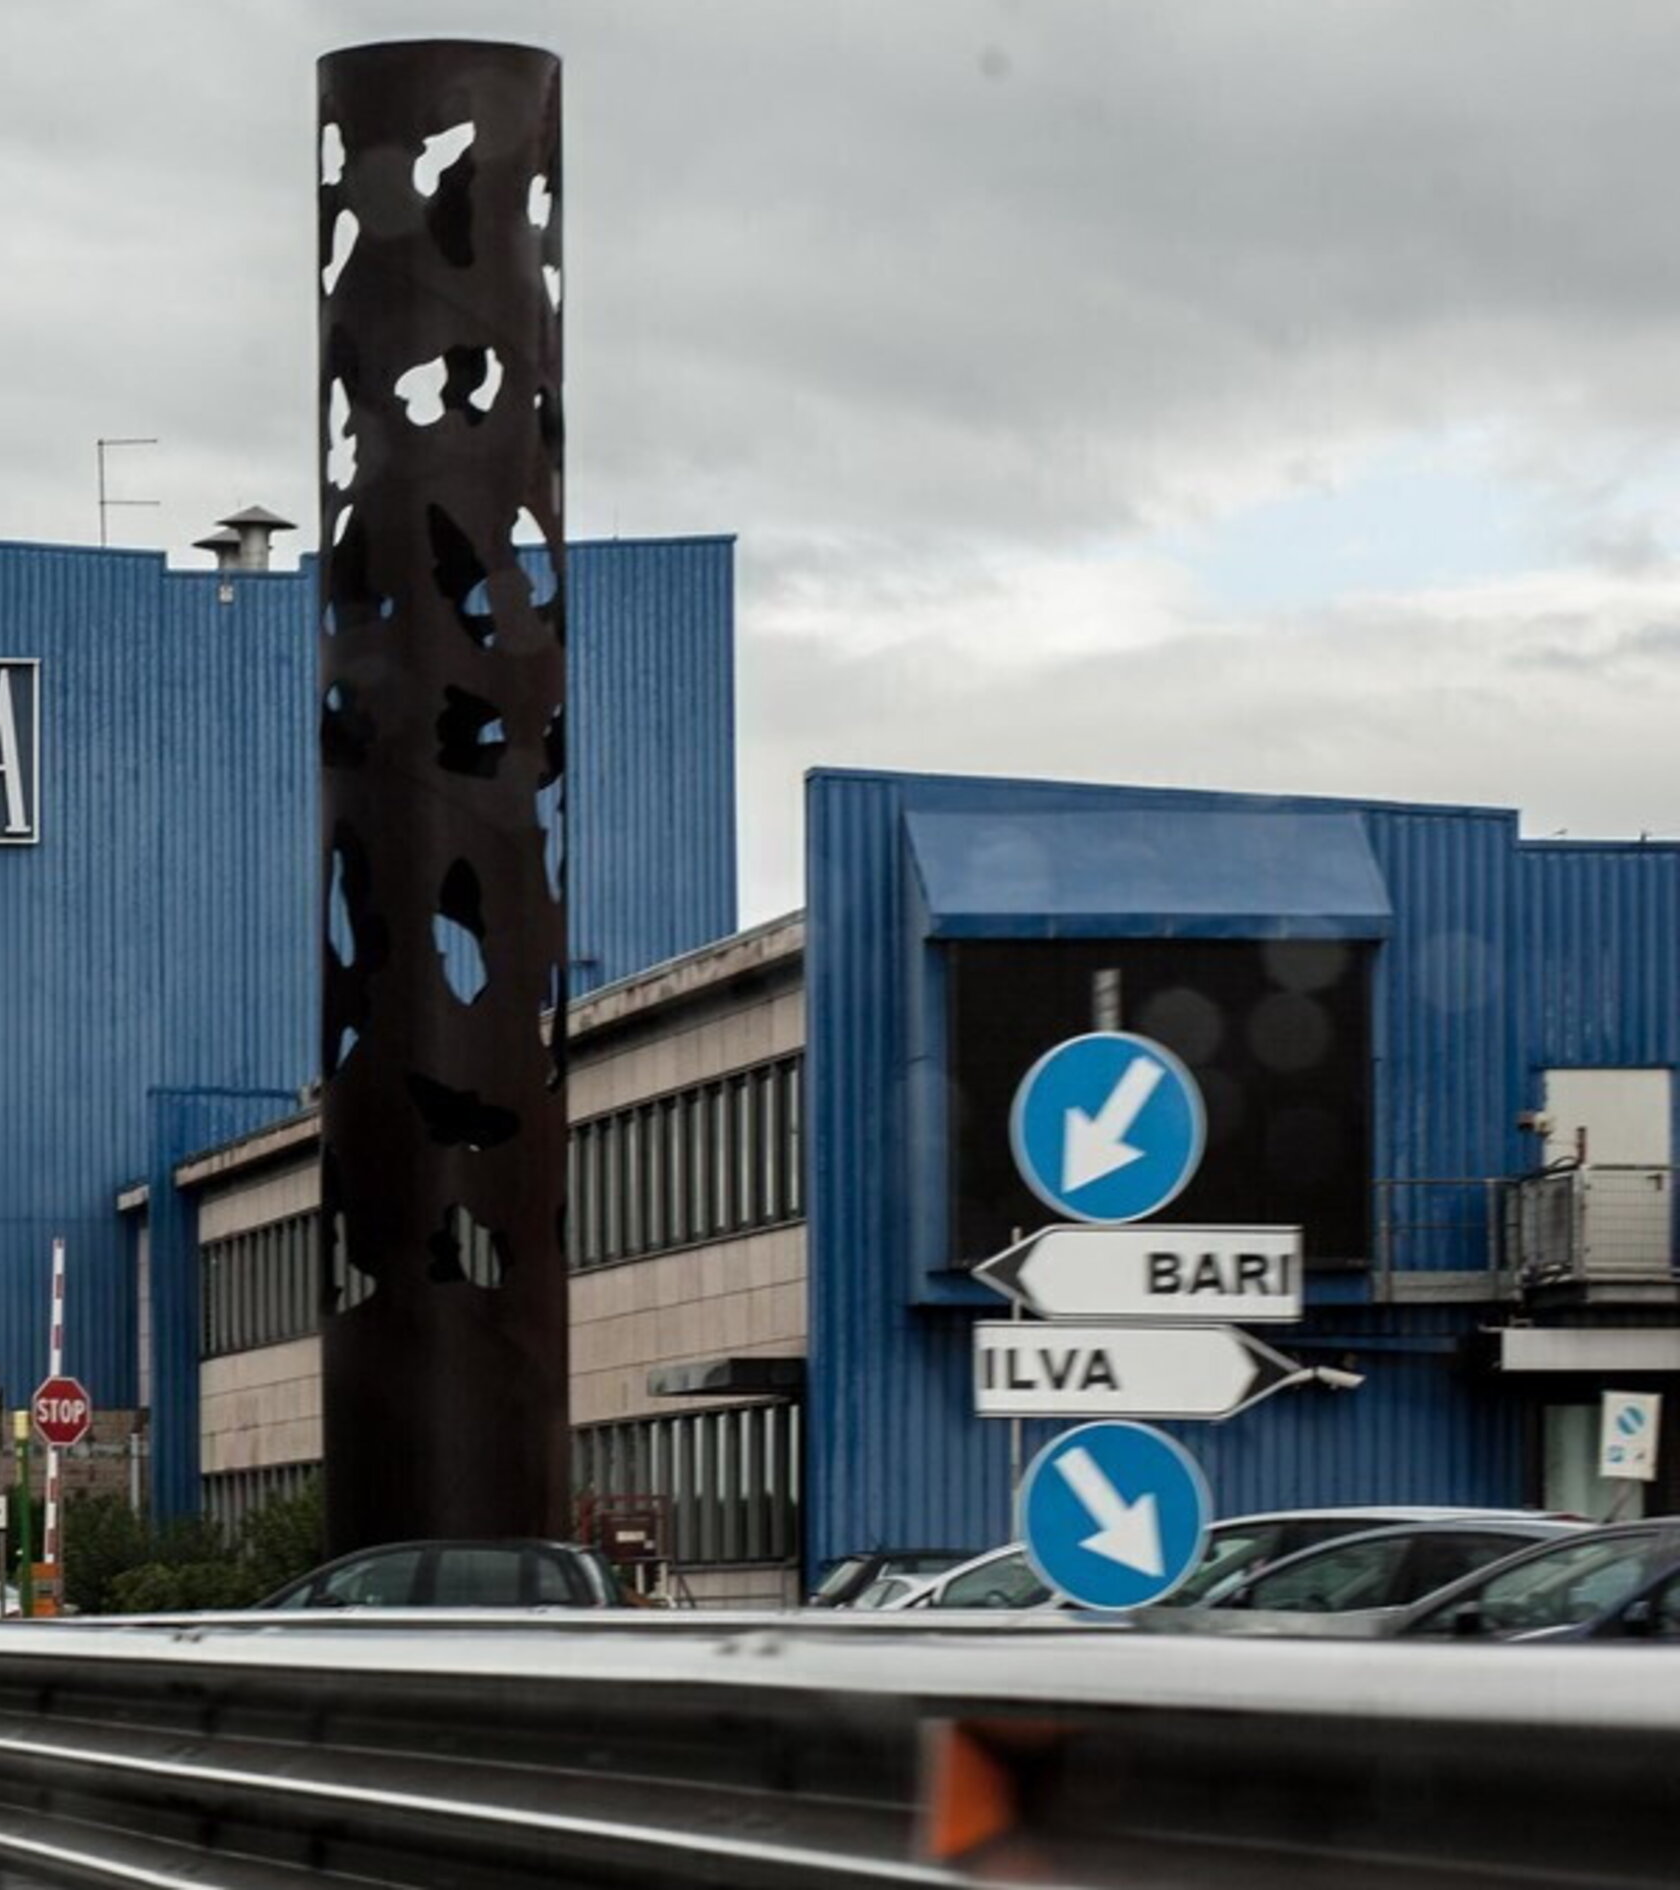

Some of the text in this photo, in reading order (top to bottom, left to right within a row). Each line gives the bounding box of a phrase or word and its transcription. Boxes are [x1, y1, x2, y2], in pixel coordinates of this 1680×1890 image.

[1148, 1252, 1294, 1296] BARI
[981, 1347, 1120, 1391] ILVA
[38, 1398, 85, 1424] STOP
